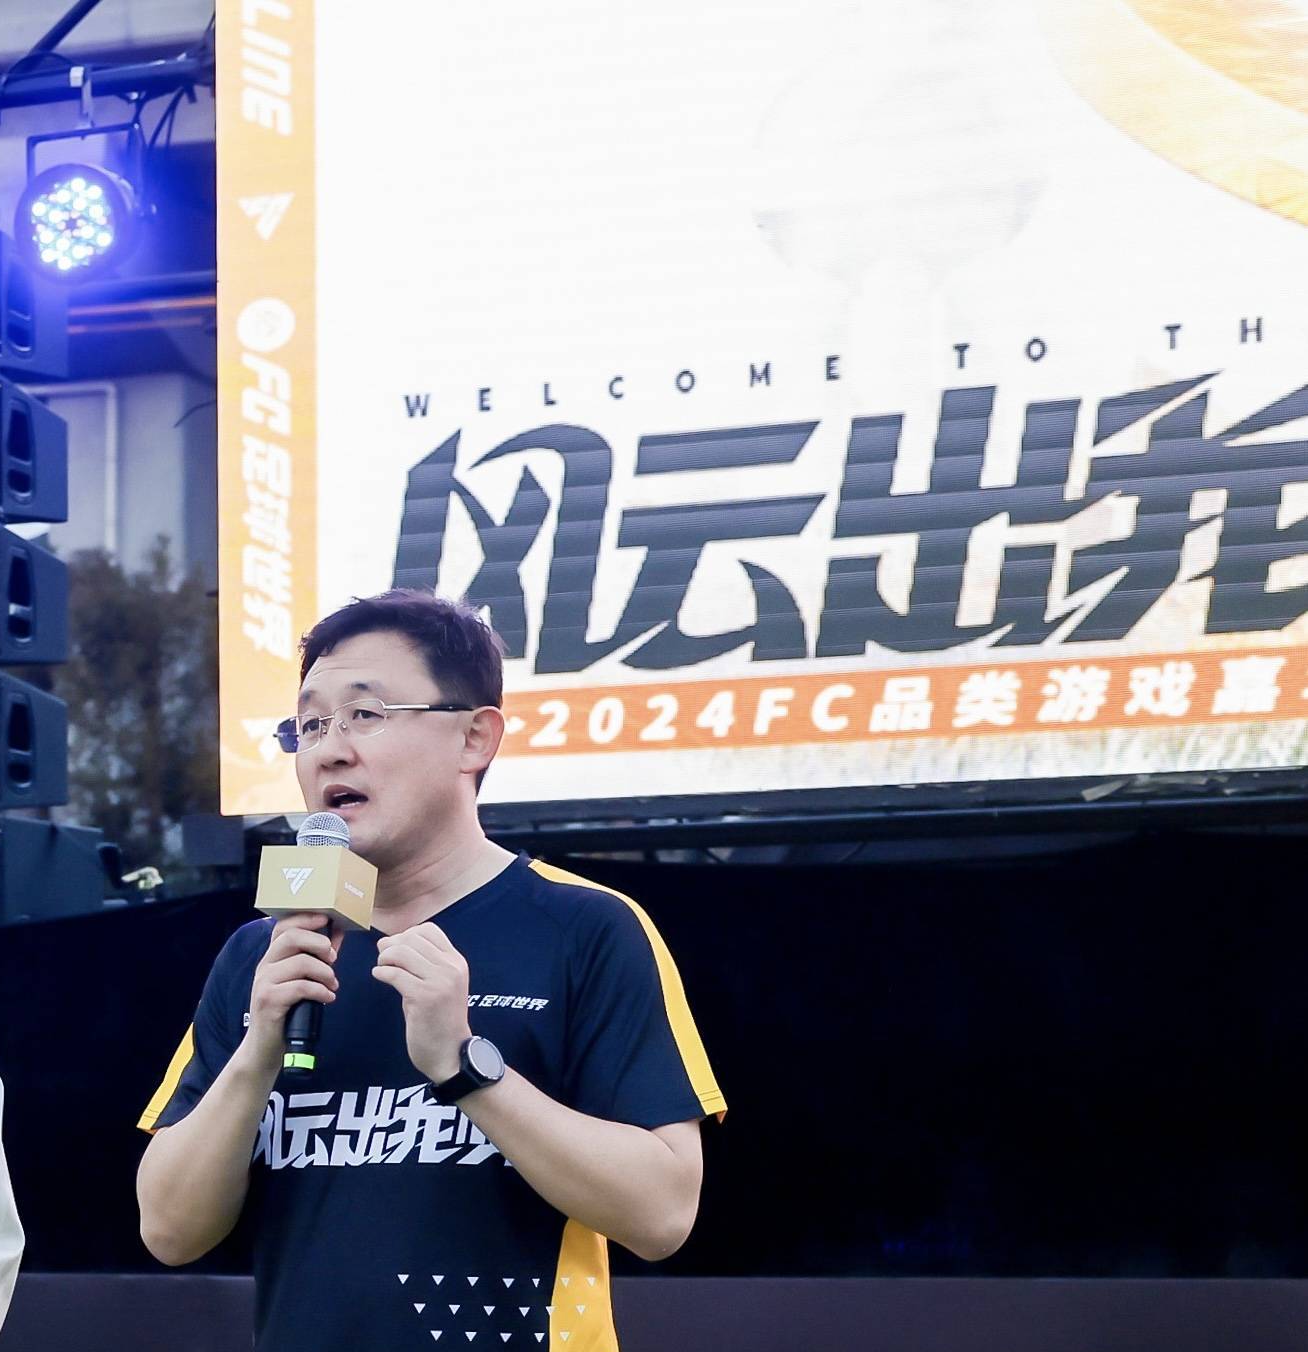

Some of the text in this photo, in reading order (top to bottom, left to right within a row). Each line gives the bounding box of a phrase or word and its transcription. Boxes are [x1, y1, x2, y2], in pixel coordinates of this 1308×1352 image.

[241, 352, 292, 436] FC
[404, 318, 1265, 418] WELCOME TO TH
[242, 434, 292, 661] 足球世界
[528, 655, 1308, 749] 2024FC品类游戏嘉
[478, 995, 550, 1011] 足球世界
